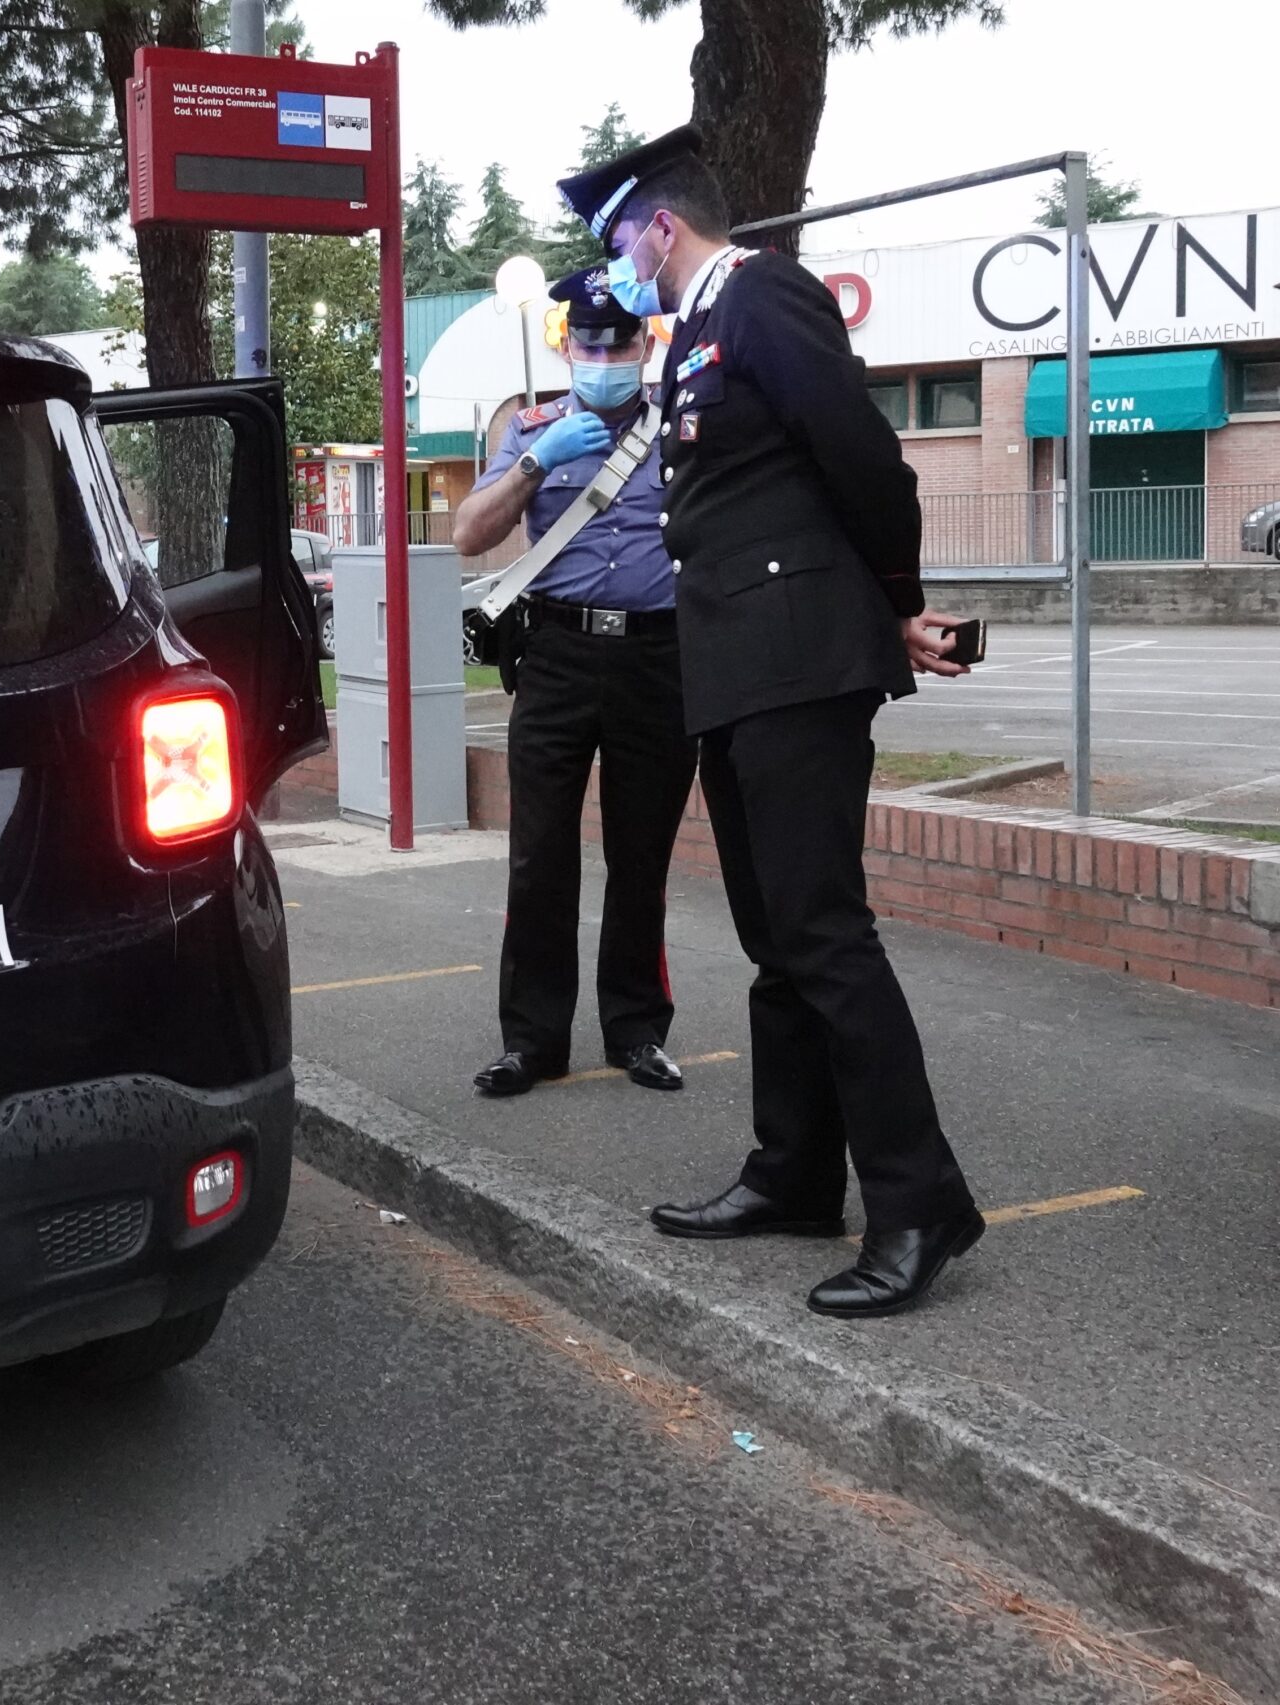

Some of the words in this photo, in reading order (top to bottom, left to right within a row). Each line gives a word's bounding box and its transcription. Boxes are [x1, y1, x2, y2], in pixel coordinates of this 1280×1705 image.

[173, 83, 198, 93] VIALE
[200, 85, 243, 95] CARDUCCI
[245, 87, 256, 96] FR
[257, 88, 267, 97] 38
[173, 95, 195, 104] Imola
[197, 96, 224, 106] Centro
[226, 98, 276, 109] Commerciale
[174, 107, 193, 116] Cod.
[195, 108, 222, 117] 114102
[972, 214, 1257, 332] CVN
[969, 335, 1067, 357] CASALING
[1110, 321, 1265, 347] ABBIGLIAMENTI
[1091, 397, 1134, 413] CVN
